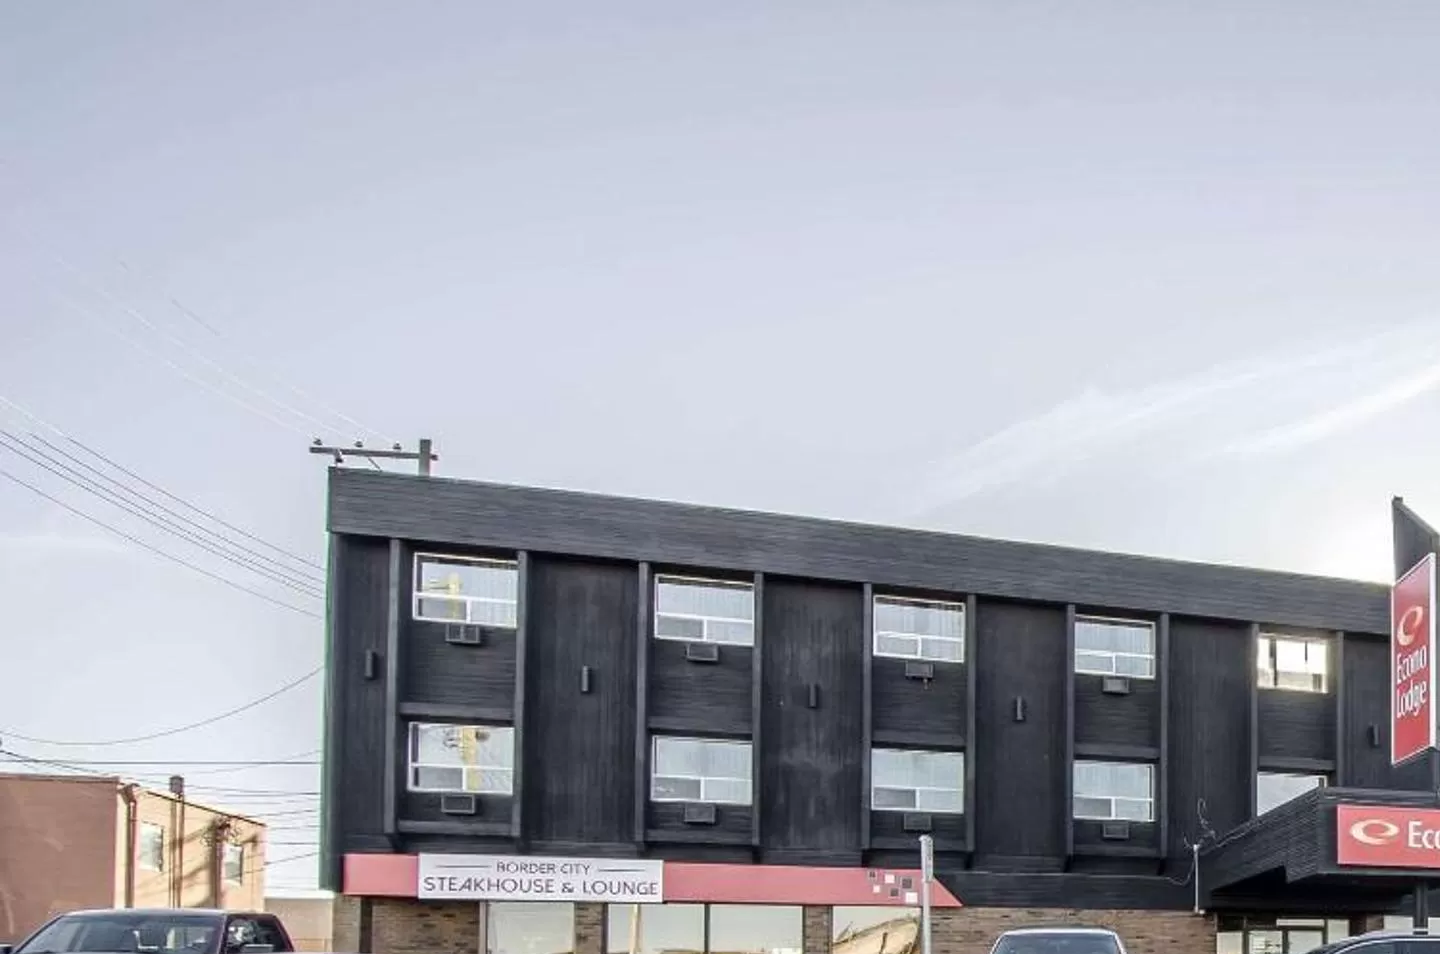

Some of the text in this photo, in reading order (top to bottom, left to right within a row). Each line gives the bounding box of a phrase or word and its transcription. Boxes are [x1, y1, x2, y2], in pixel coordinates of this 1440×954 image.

[1396, 645, 1427, 685] Econo
[1396, 679, 1427, 718] Lodge
[496, 861, 591, 874] BORDER CITY
[423, 877, 658, 895] STEAKHOUSE & LOUNGE
